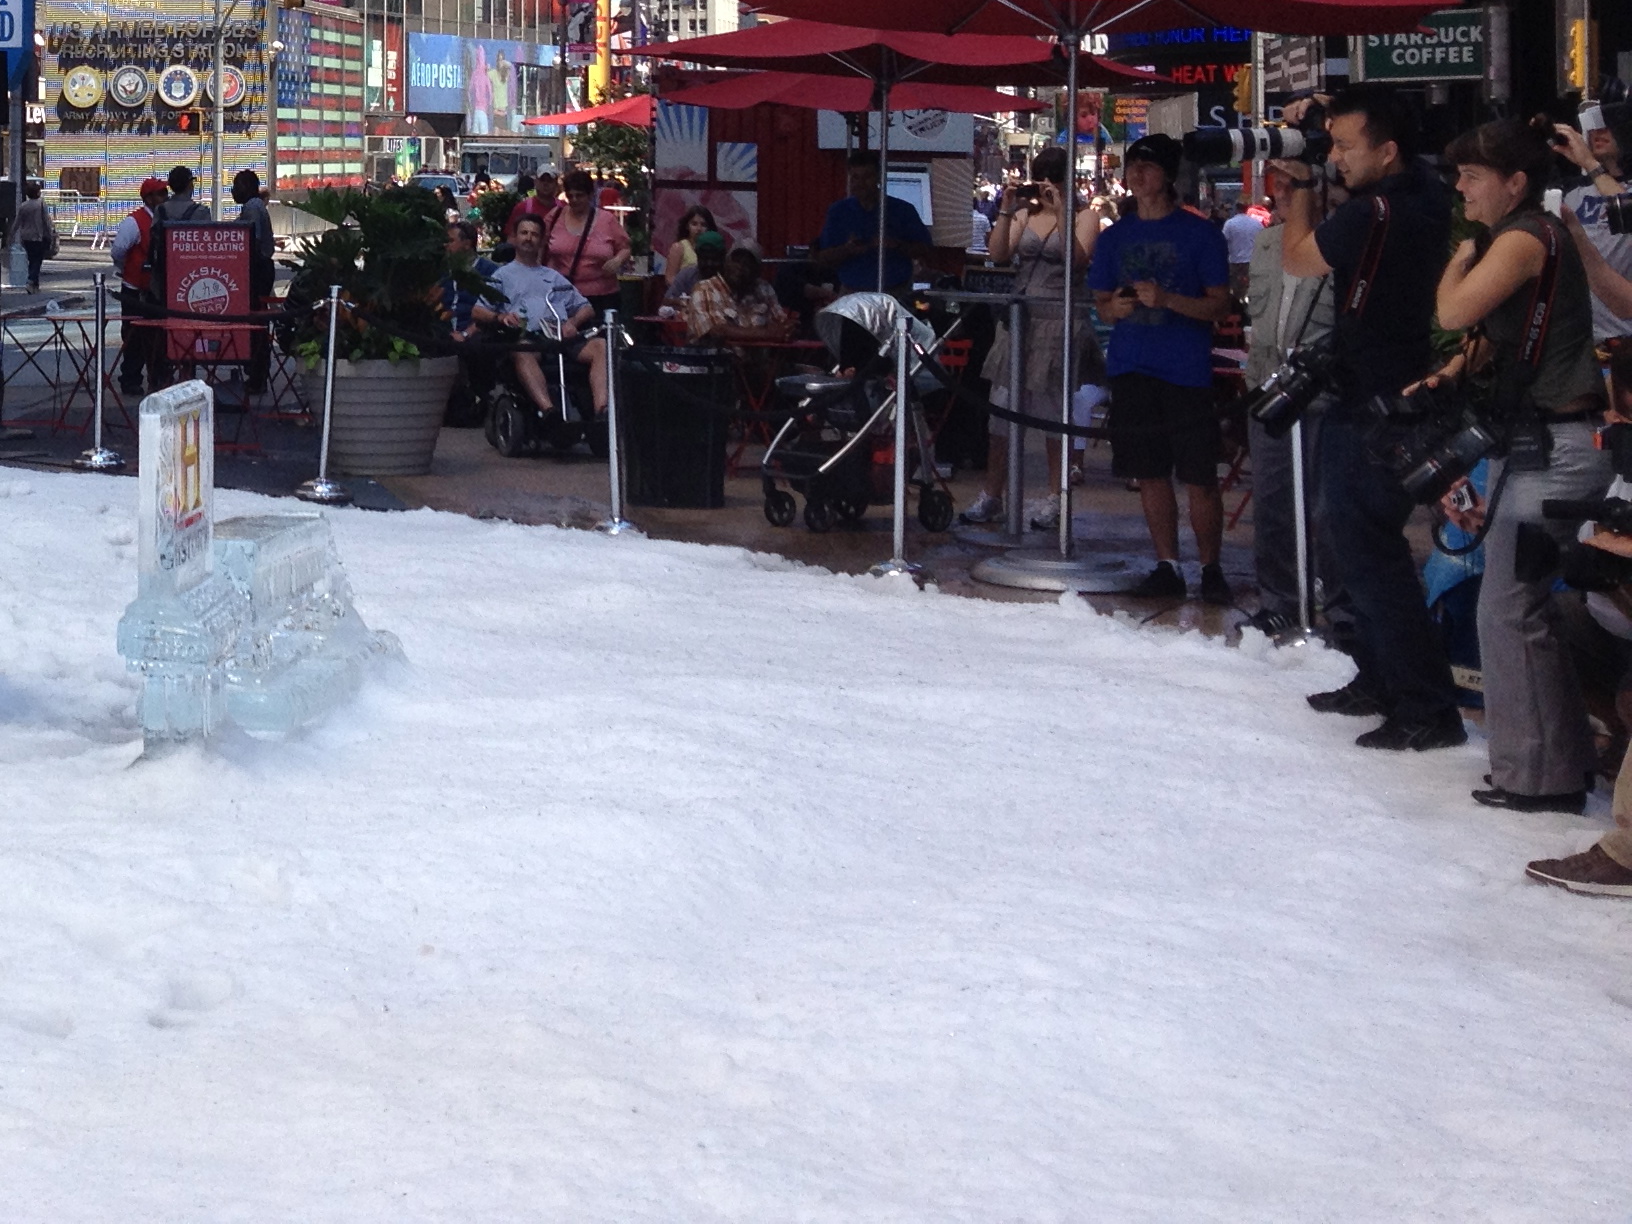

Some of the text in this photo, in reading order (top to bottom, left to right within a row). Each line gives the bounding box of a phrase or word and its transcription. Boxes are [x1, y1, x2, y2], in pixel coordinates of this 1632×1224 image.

[61, 43, 248, 58] RECRUITING STATON
[1391, 46, 1474, 66] COFFEE
[1171, 65, 1217, 85] HEAT
[63, 112, 90, 121] ARMY
[205, 112, 249, 122] MRINES
[172, 230, 245, 241] FREE & OPEN
[172, 243, 245, 252] PUBLIC SEATING
[176, 266, 240, 303] RICKSHAW
